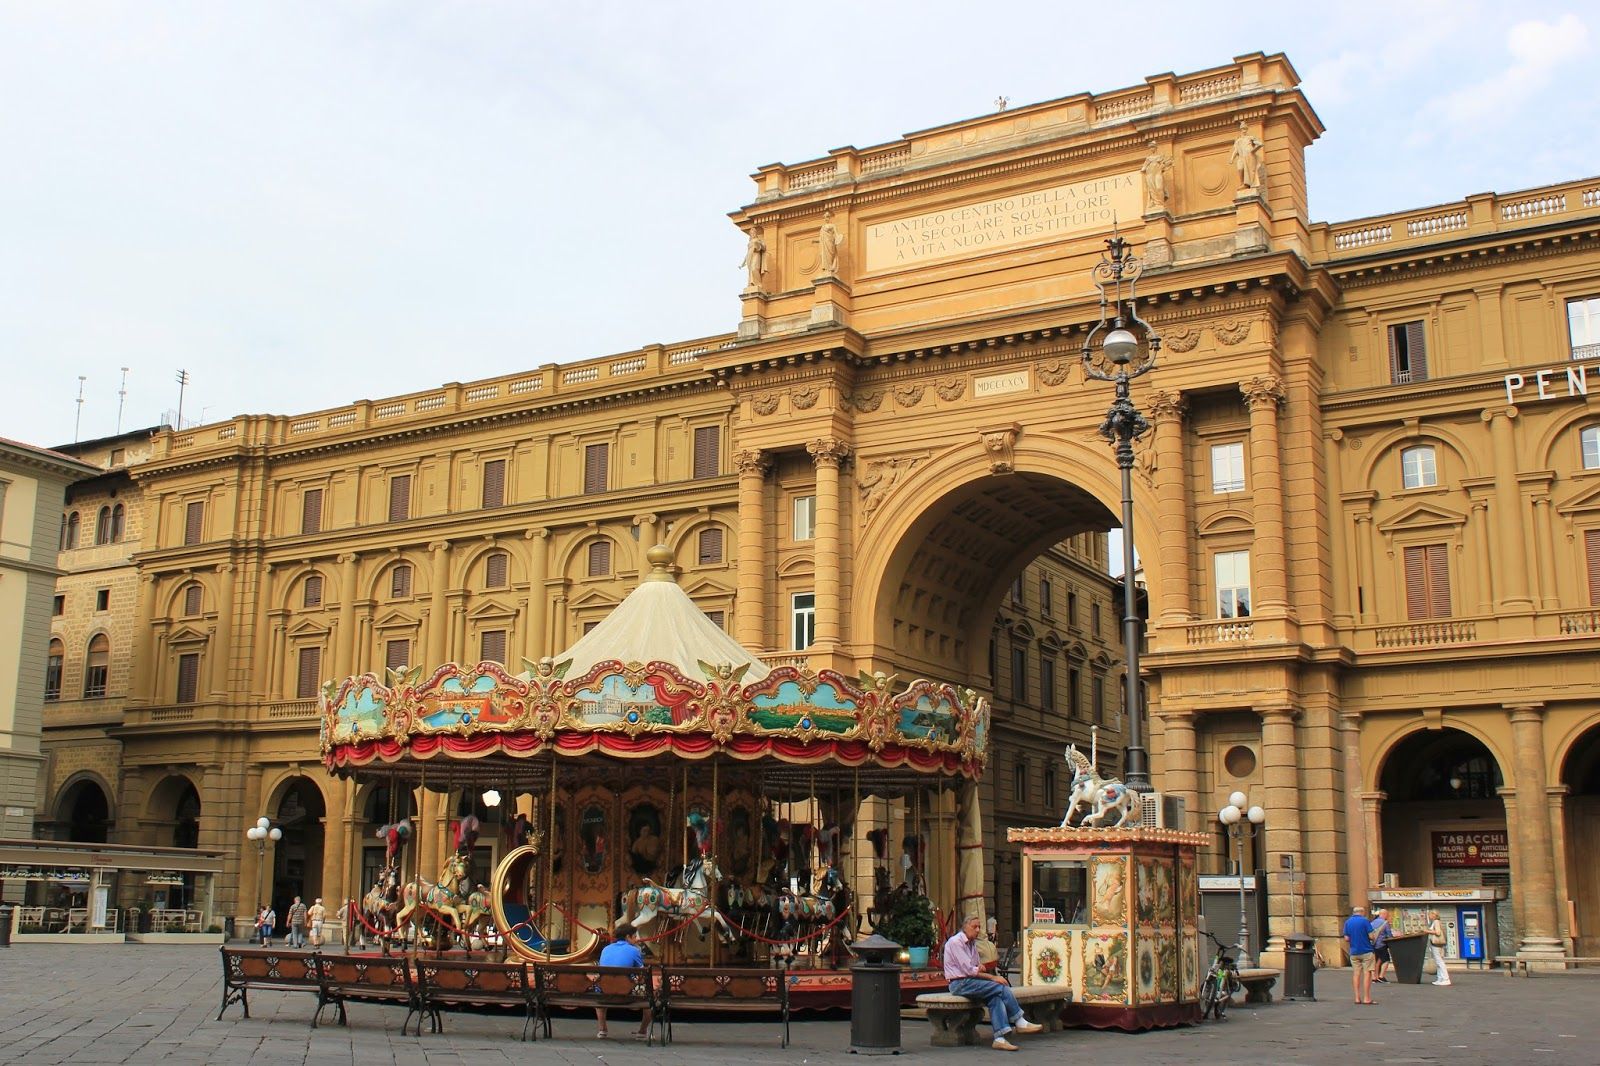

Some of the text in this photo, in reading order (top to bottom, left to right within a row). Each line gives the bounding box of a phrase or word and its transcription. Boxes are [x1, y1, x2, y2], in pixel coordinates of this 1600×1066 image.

[895, 194, 1110, 248] DA SECOLARE SQUALLORE
[951, 200, 1015, 221] CENTRO
[1021, 188, 1076, 208] DELLA
[896, 208, 1111, 261] A VITA NUOVA RESTITUITO
[1504, 364, 1600, 404] PEN
[1441, 834, 1504, 844] TABACCHI
